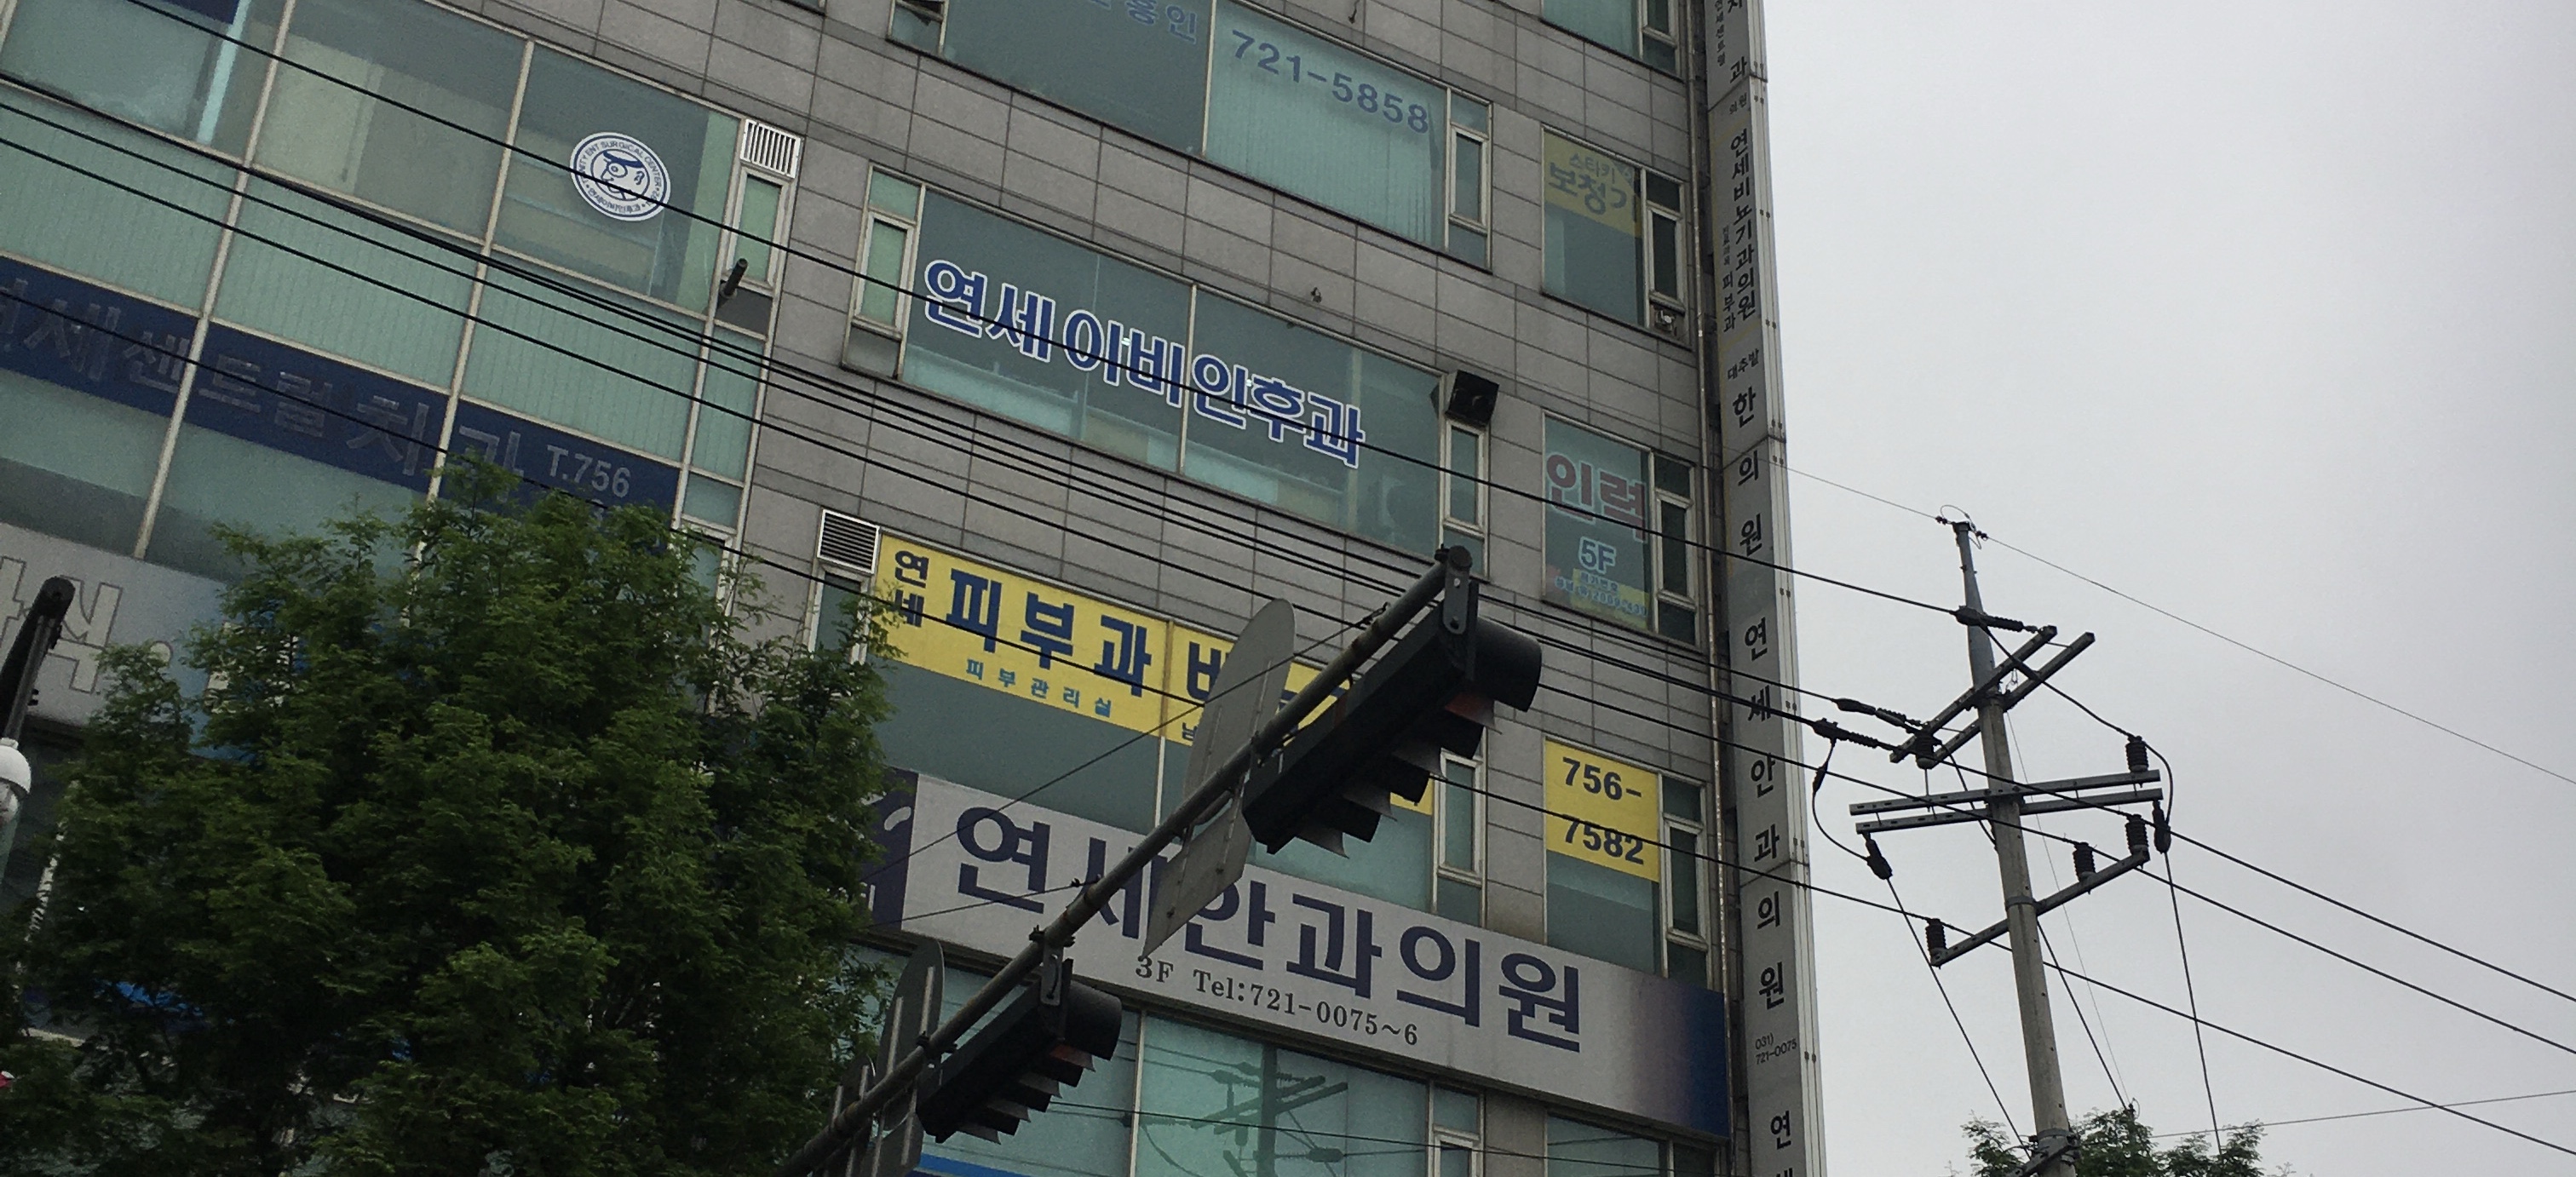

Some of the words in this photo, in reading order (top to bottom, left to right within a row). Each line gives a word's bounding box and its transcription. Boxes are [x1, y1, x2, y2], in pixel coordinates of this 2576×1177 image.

[1232, 29, 1429, 135] 721-5858
[587, 143, 601, 158] ENT
[601, 141, 645, 158] SURGICAL
[644, 155, 662, 190] CENTER
[1548, 162, 1637, 222] 보청기
[1569, 153, 1615, 185] 스타키
[1730, 128, 1756, 321] 연세비뇨기과의원
[1722, 271, 1736, 332] 피부과
[547, 445, 630, 497] T.756
[1546, 453, 1646, 543] 인력
[1579, 537, 1617, 574] 5F
[946, 568, 1152, 698] 피부과
[966, 658, 1112, 718] 피부관리실
[1562, 757, 1642, 801] 756-
[1562, 814, 1644, 865] 7582
[1745, 617, 1785, 1010] 연세안과의원
[957, 807, 1580, 1053] 연세안과의원
[1136, 956, 1174, 984] 3F
[1755, 1032, 1774, 1050] 031)
[1756, 1037, 1797, 1065] 721-0075
